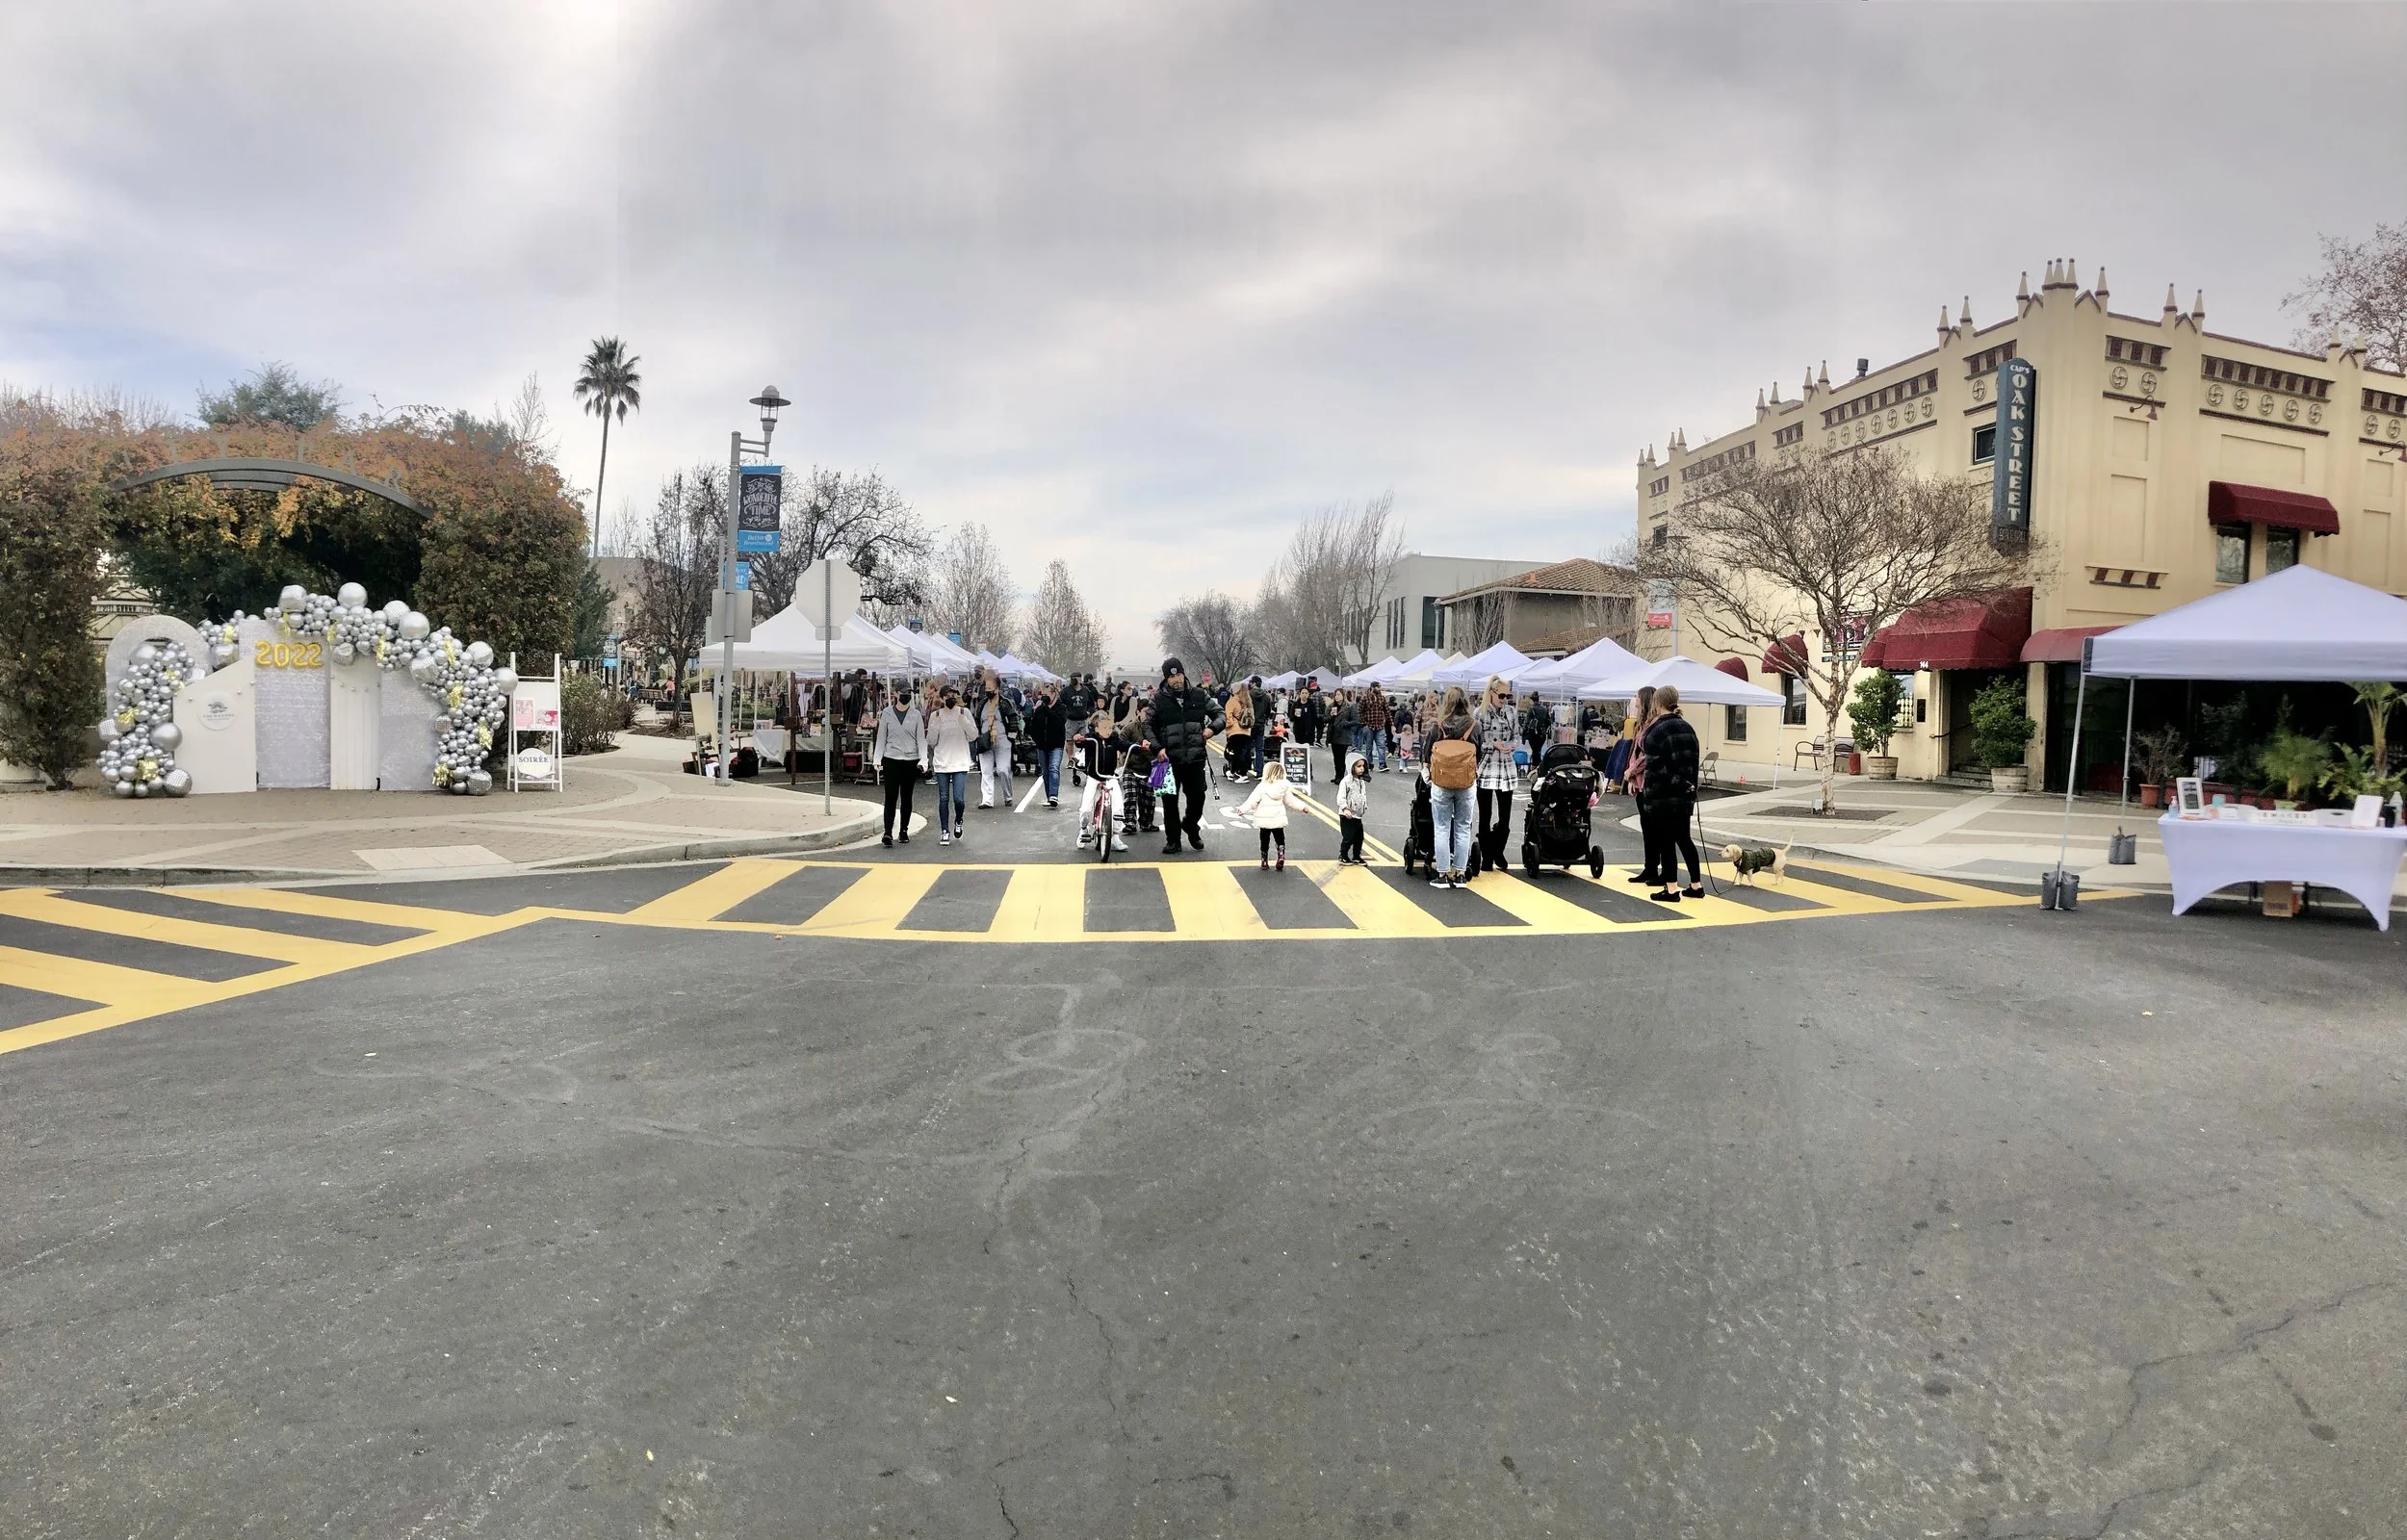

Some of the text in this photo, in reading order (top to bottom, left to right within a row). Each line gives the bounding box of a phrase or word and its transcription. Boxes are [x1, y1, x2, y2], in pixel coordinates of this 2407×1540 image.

[2011, 374, 2027, 420] OAK
[2007, 426, 2025, 522] STREET
[749, 505, 771, 516] TIME
[254, 640, 324, 669] 2022
[518, 755, 549, 763] SOIRÉE
